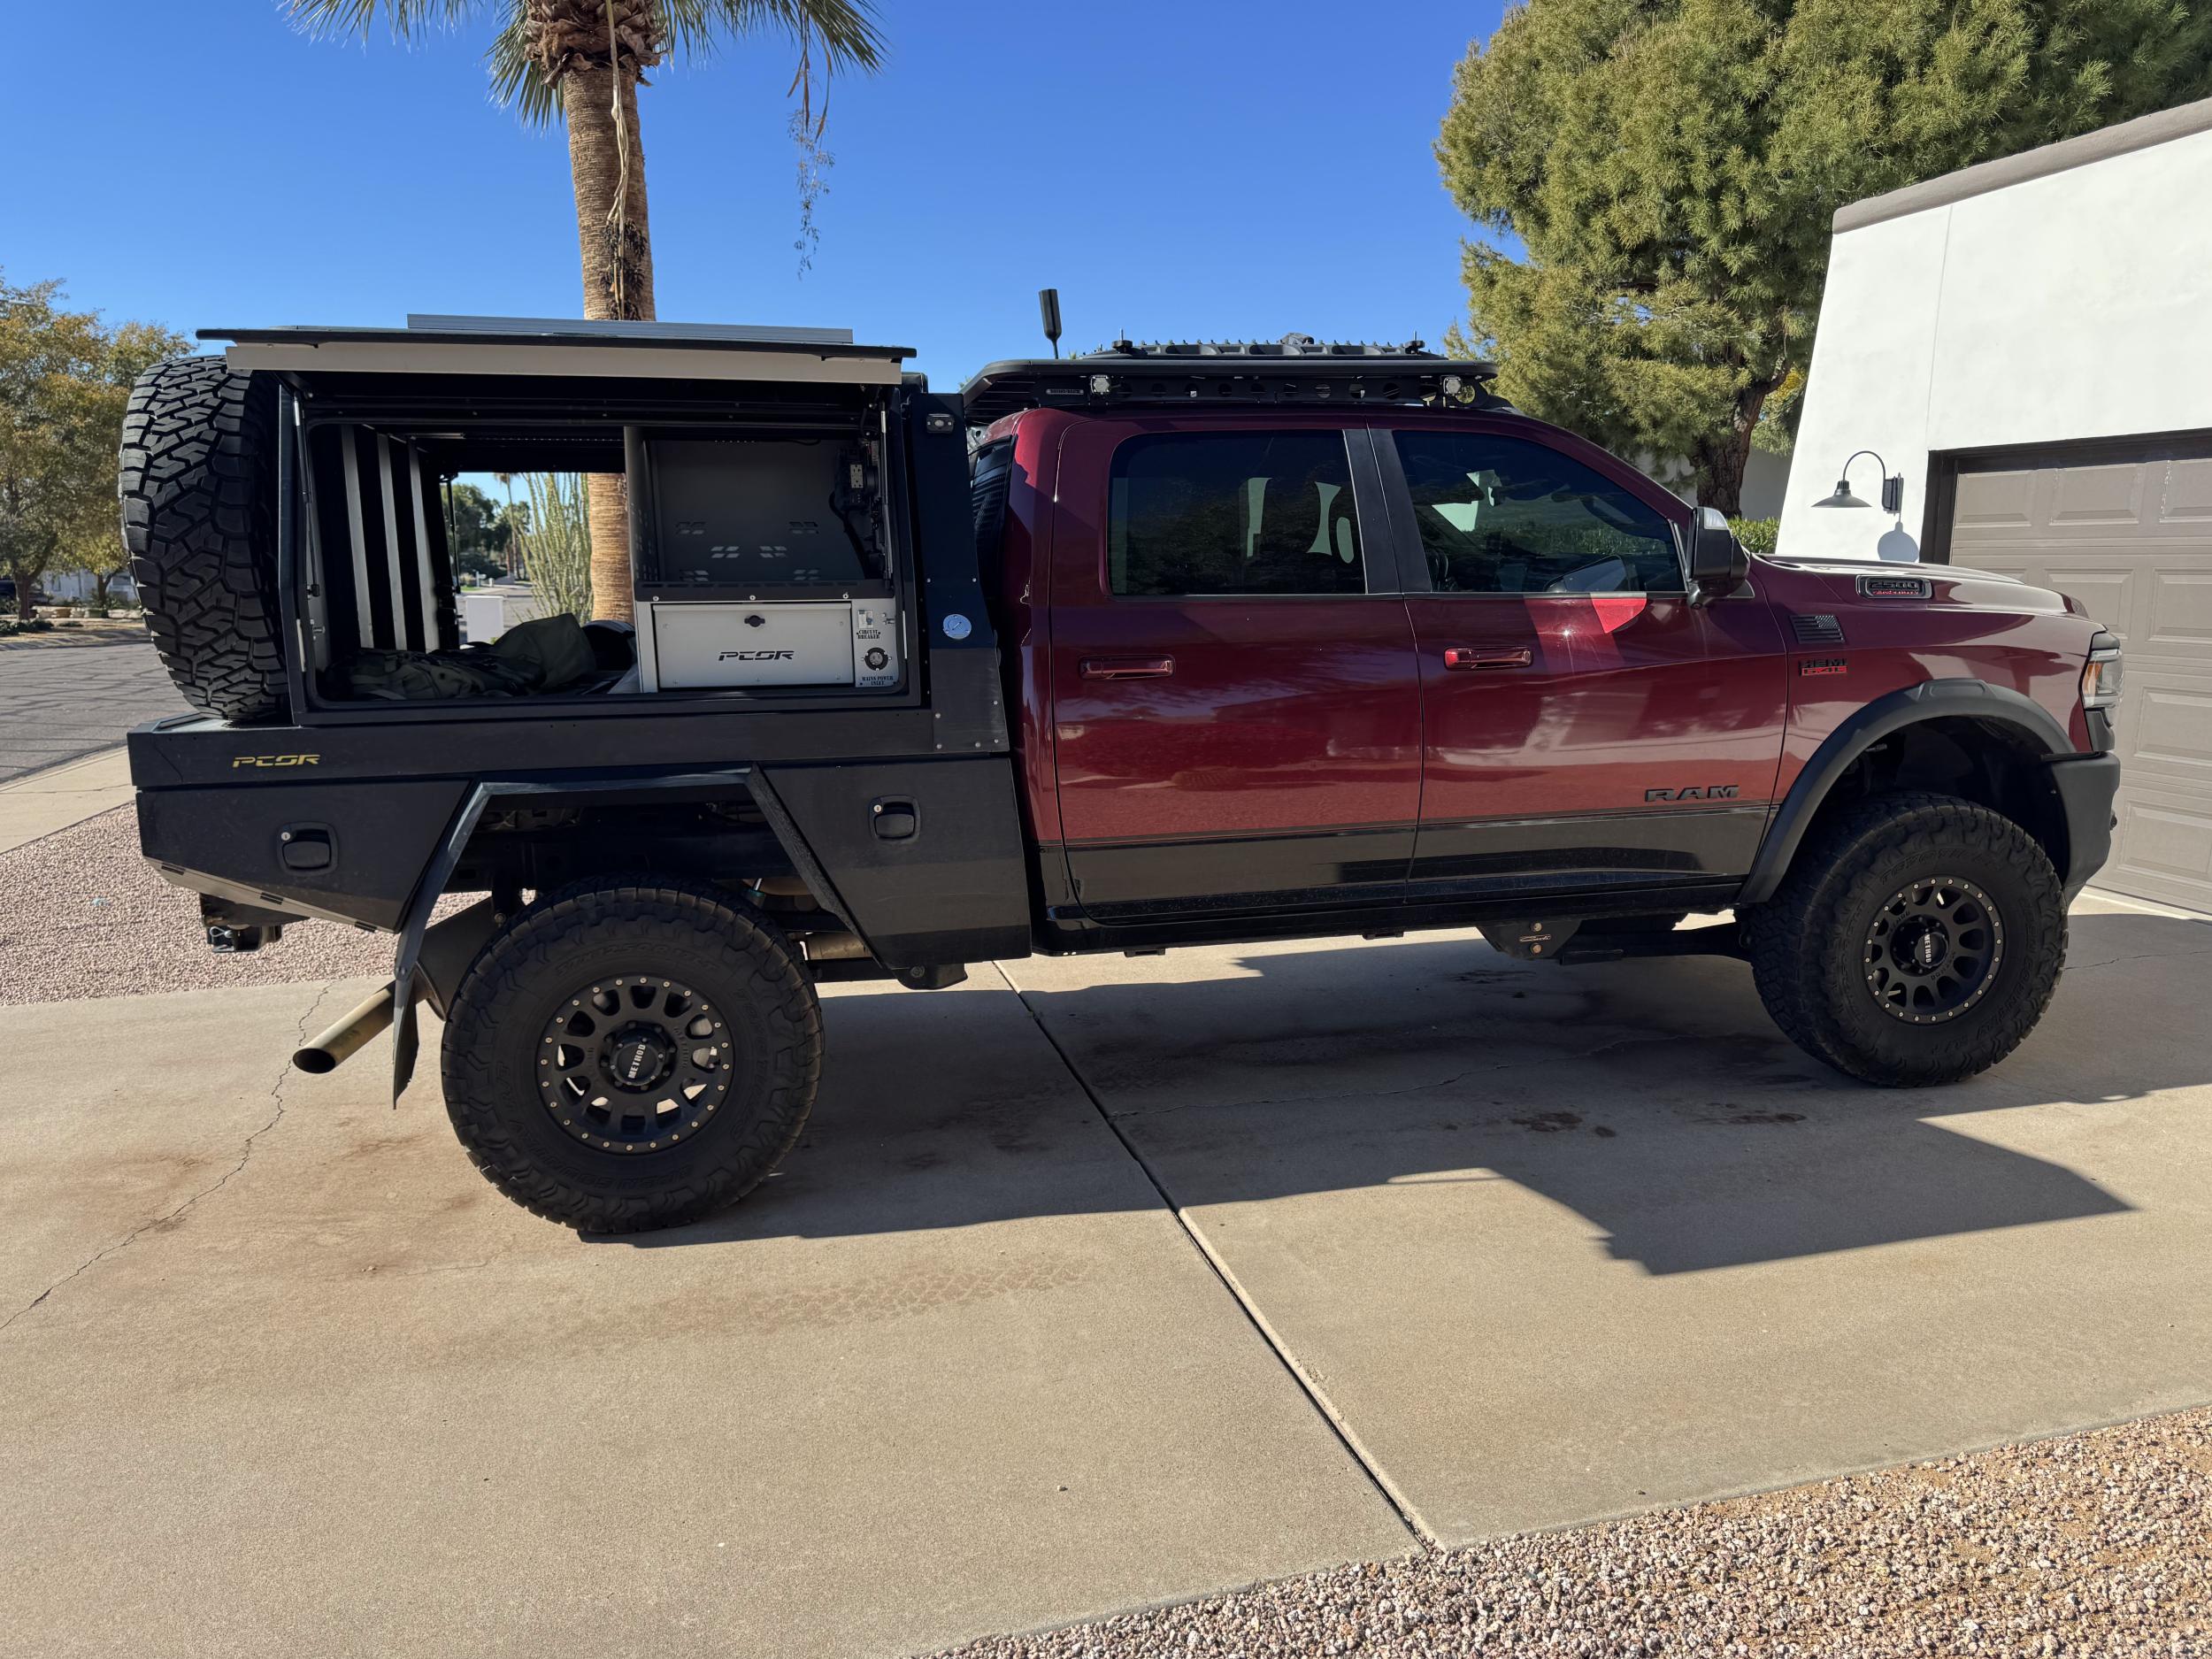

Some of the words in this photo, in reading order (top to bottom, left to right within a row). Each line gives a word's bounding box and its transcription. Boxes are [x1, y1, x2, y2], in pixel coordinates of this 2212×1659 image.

[1644, 785, 1740, 803] RAM
[1923, 933, 1932, 964] METHOD
[626, 1043, 647, 1079] METHOD
